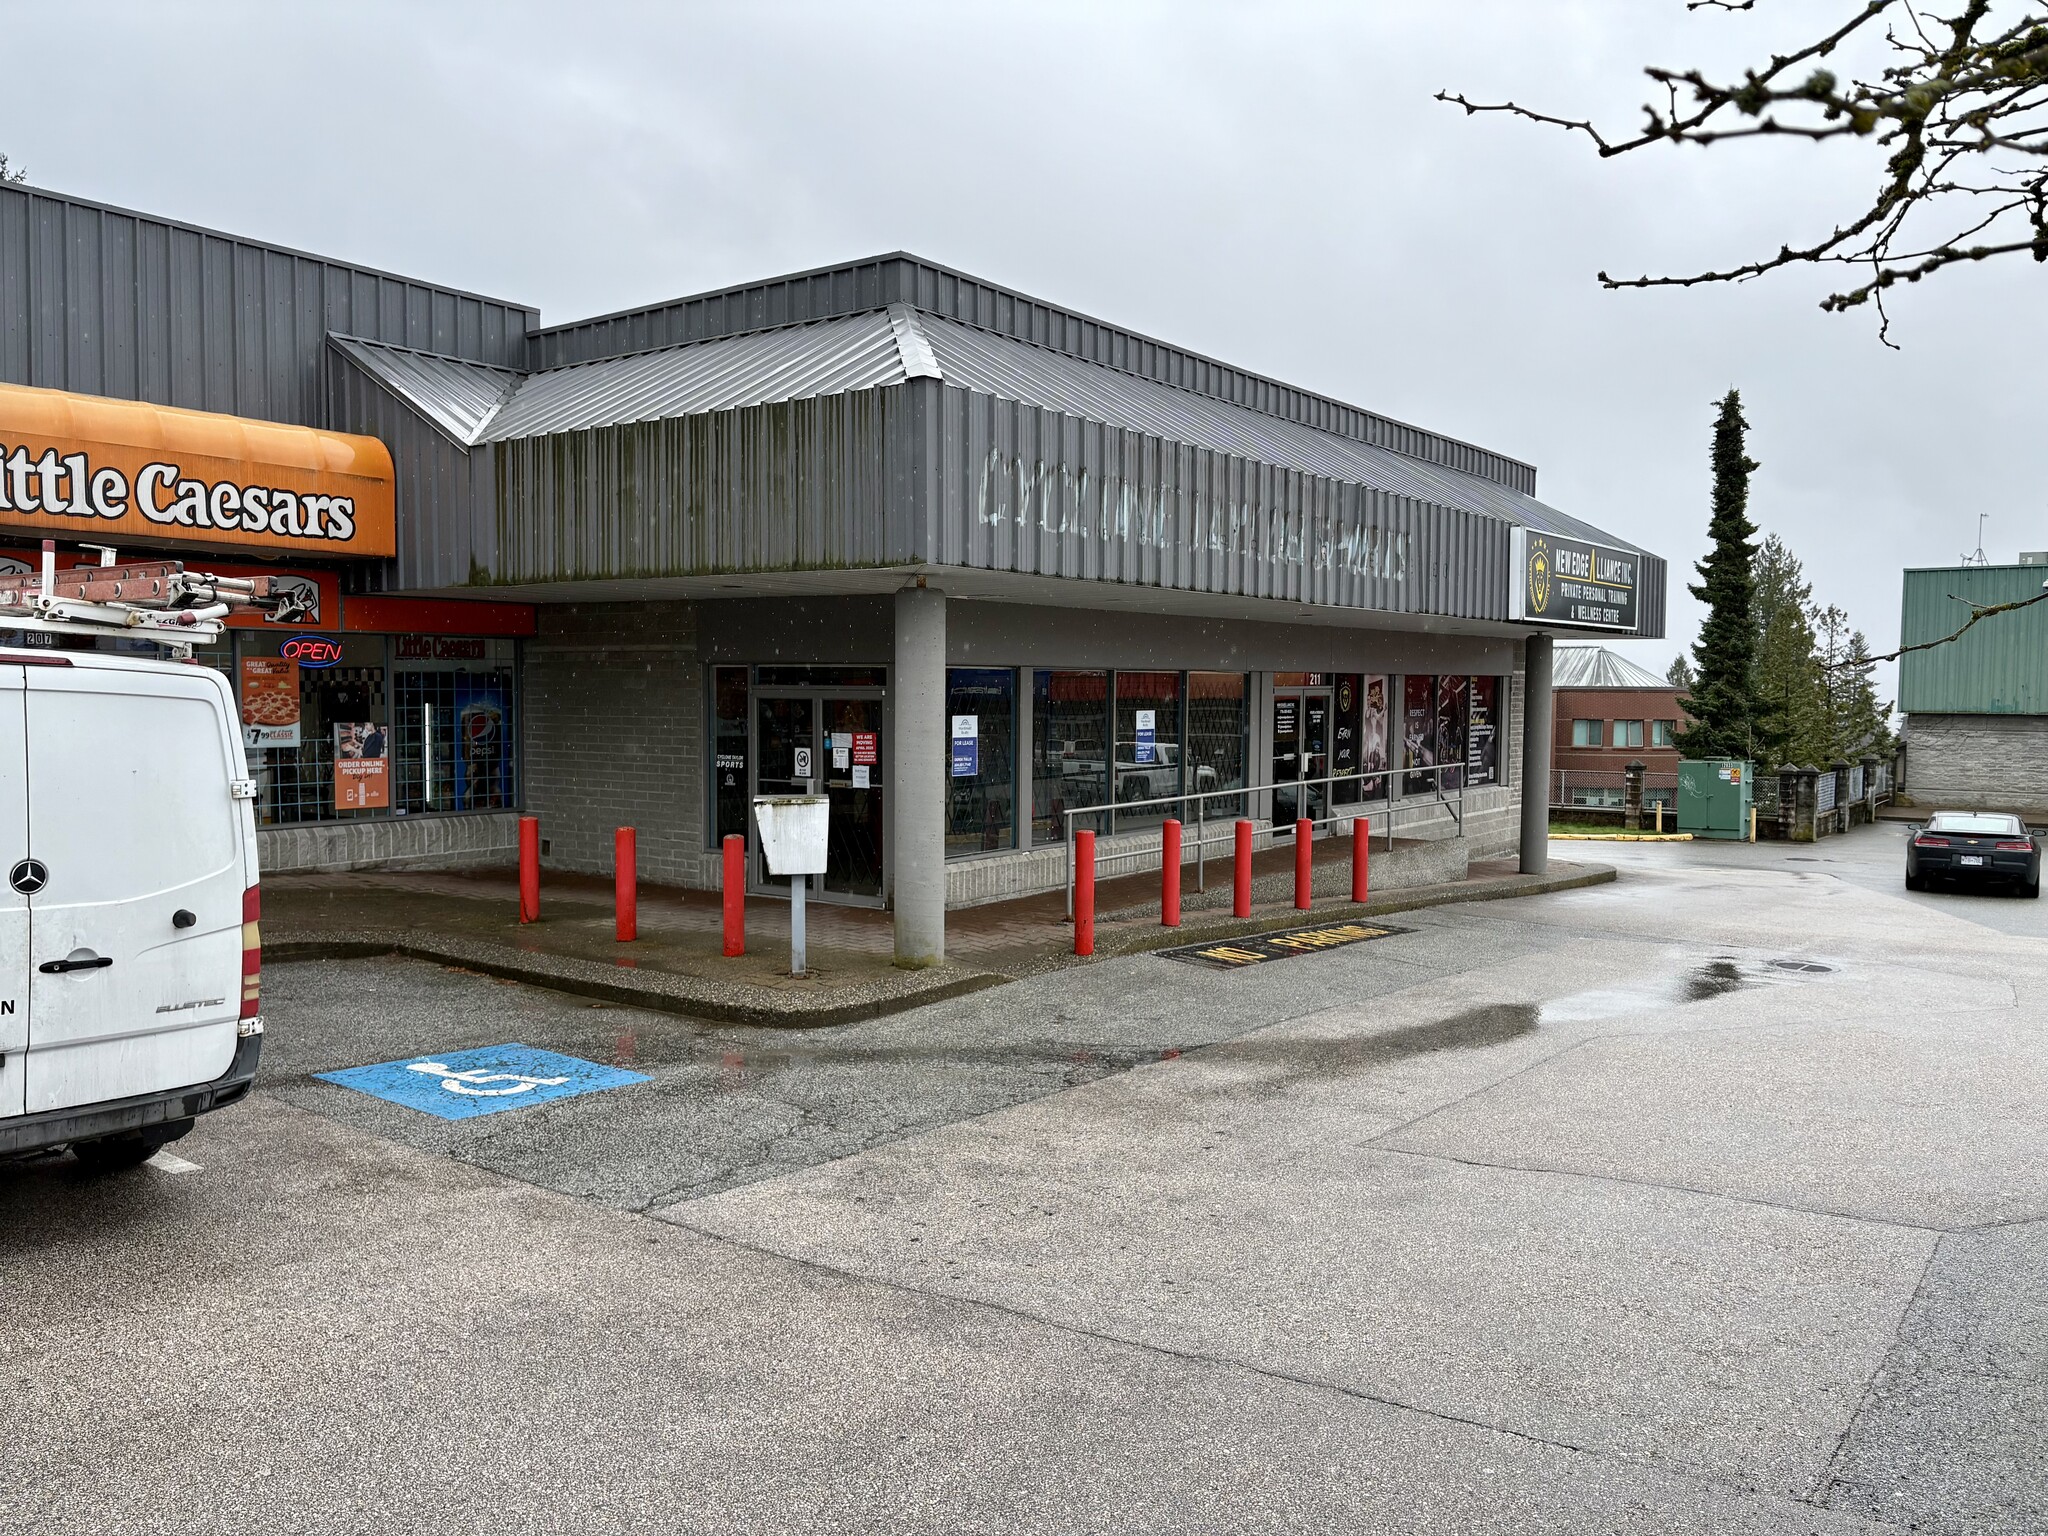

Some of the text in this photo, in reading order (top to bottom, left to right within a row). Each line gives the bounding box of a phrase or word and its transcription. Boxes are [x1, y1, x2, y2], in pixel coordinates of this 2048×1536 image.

[0, 445, 355, 540] ittle Caesars
[1555, 548, 1572, 574] NEW
[1572, 552, 1589, 577] EDGE
[1561, 583, 1628, 605] PRIVATE PERSONAL TRAINING
[1571, 605, 1619, 623] & WELLNESS CENTRE
[26, 632, 52, 645] 207
[284, 641, 342, 660] OPEN
[1309, 673, 1321, 685] 211
[1337, 727, 1352, 740] EARN
[471, 746, 495, 756] pepsi
[1338, 748, 1351, 760] YOUR
[716, 760, 744, 769] SPORTS
[1197, 925, 1390, 964] NO PARKING
